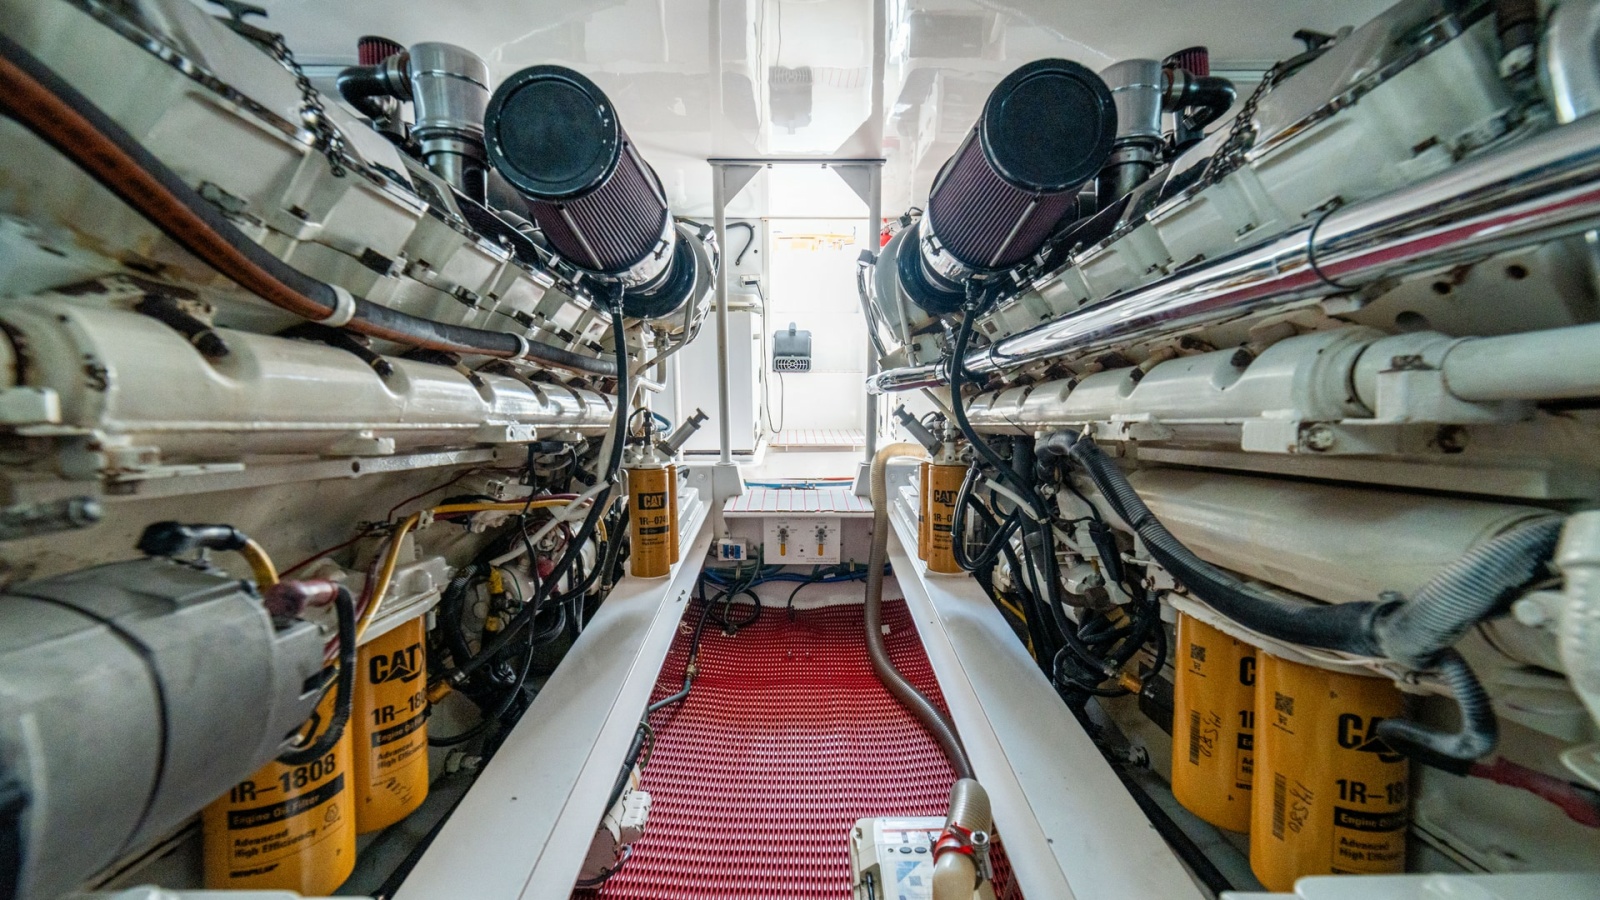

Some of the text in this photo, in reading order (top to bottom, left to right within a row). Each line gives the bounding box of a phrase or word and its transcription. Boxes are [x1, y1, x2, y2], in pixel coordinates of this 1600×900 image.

[643, 495, 663, 508] CAT
[370, 642, 420, 684] CAT
[230, 753, 336, 804] 1R-1808
